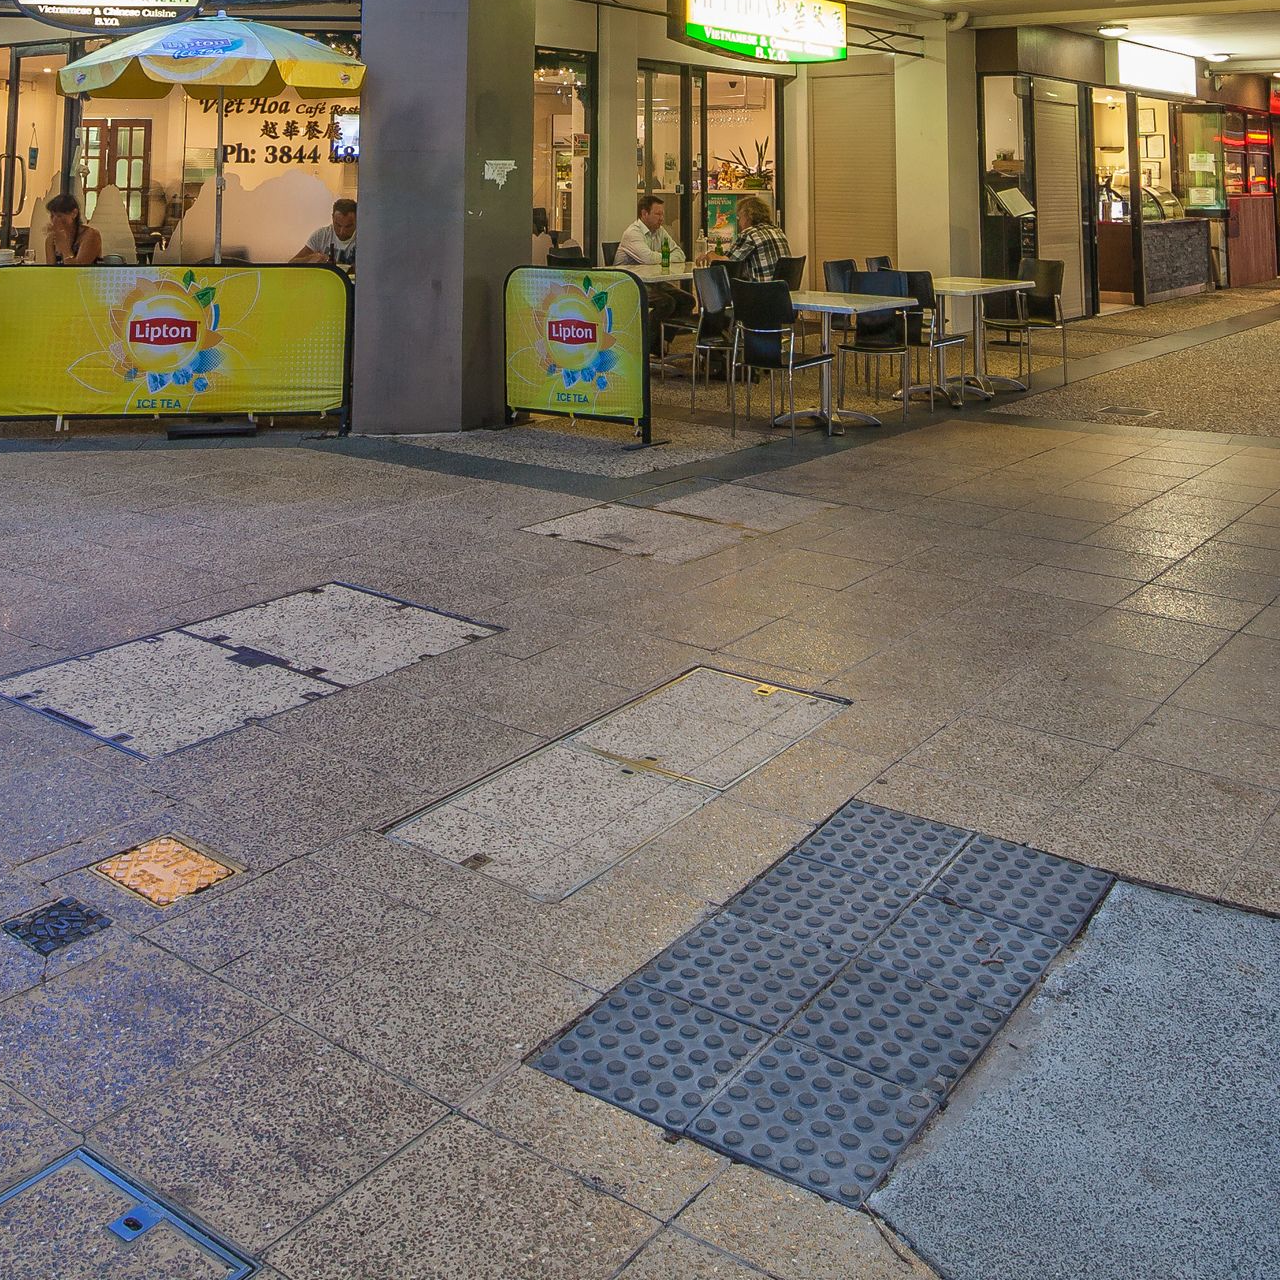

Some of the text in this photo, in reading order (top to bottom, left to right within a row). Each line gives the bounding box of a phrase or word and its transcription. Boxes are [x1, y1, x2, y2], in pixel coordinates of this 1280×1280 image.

[37, 4, 93, 17] Vietnamese
[103, 6, 141, 18] Chinese
[141, 7, 177, 19] Cuisine
[247, 97, 292, 115] Hoa
[295, 101, 327, 118] Café
[221, 142, 360, 164] Ph: 3844 48
[134, 322, 192, 342] Lipton
[551, 323, 593, 341] Lipton
[136, 398, 182, 409] ICE TEA
[556, 392, 589, 404] ICE TEA
